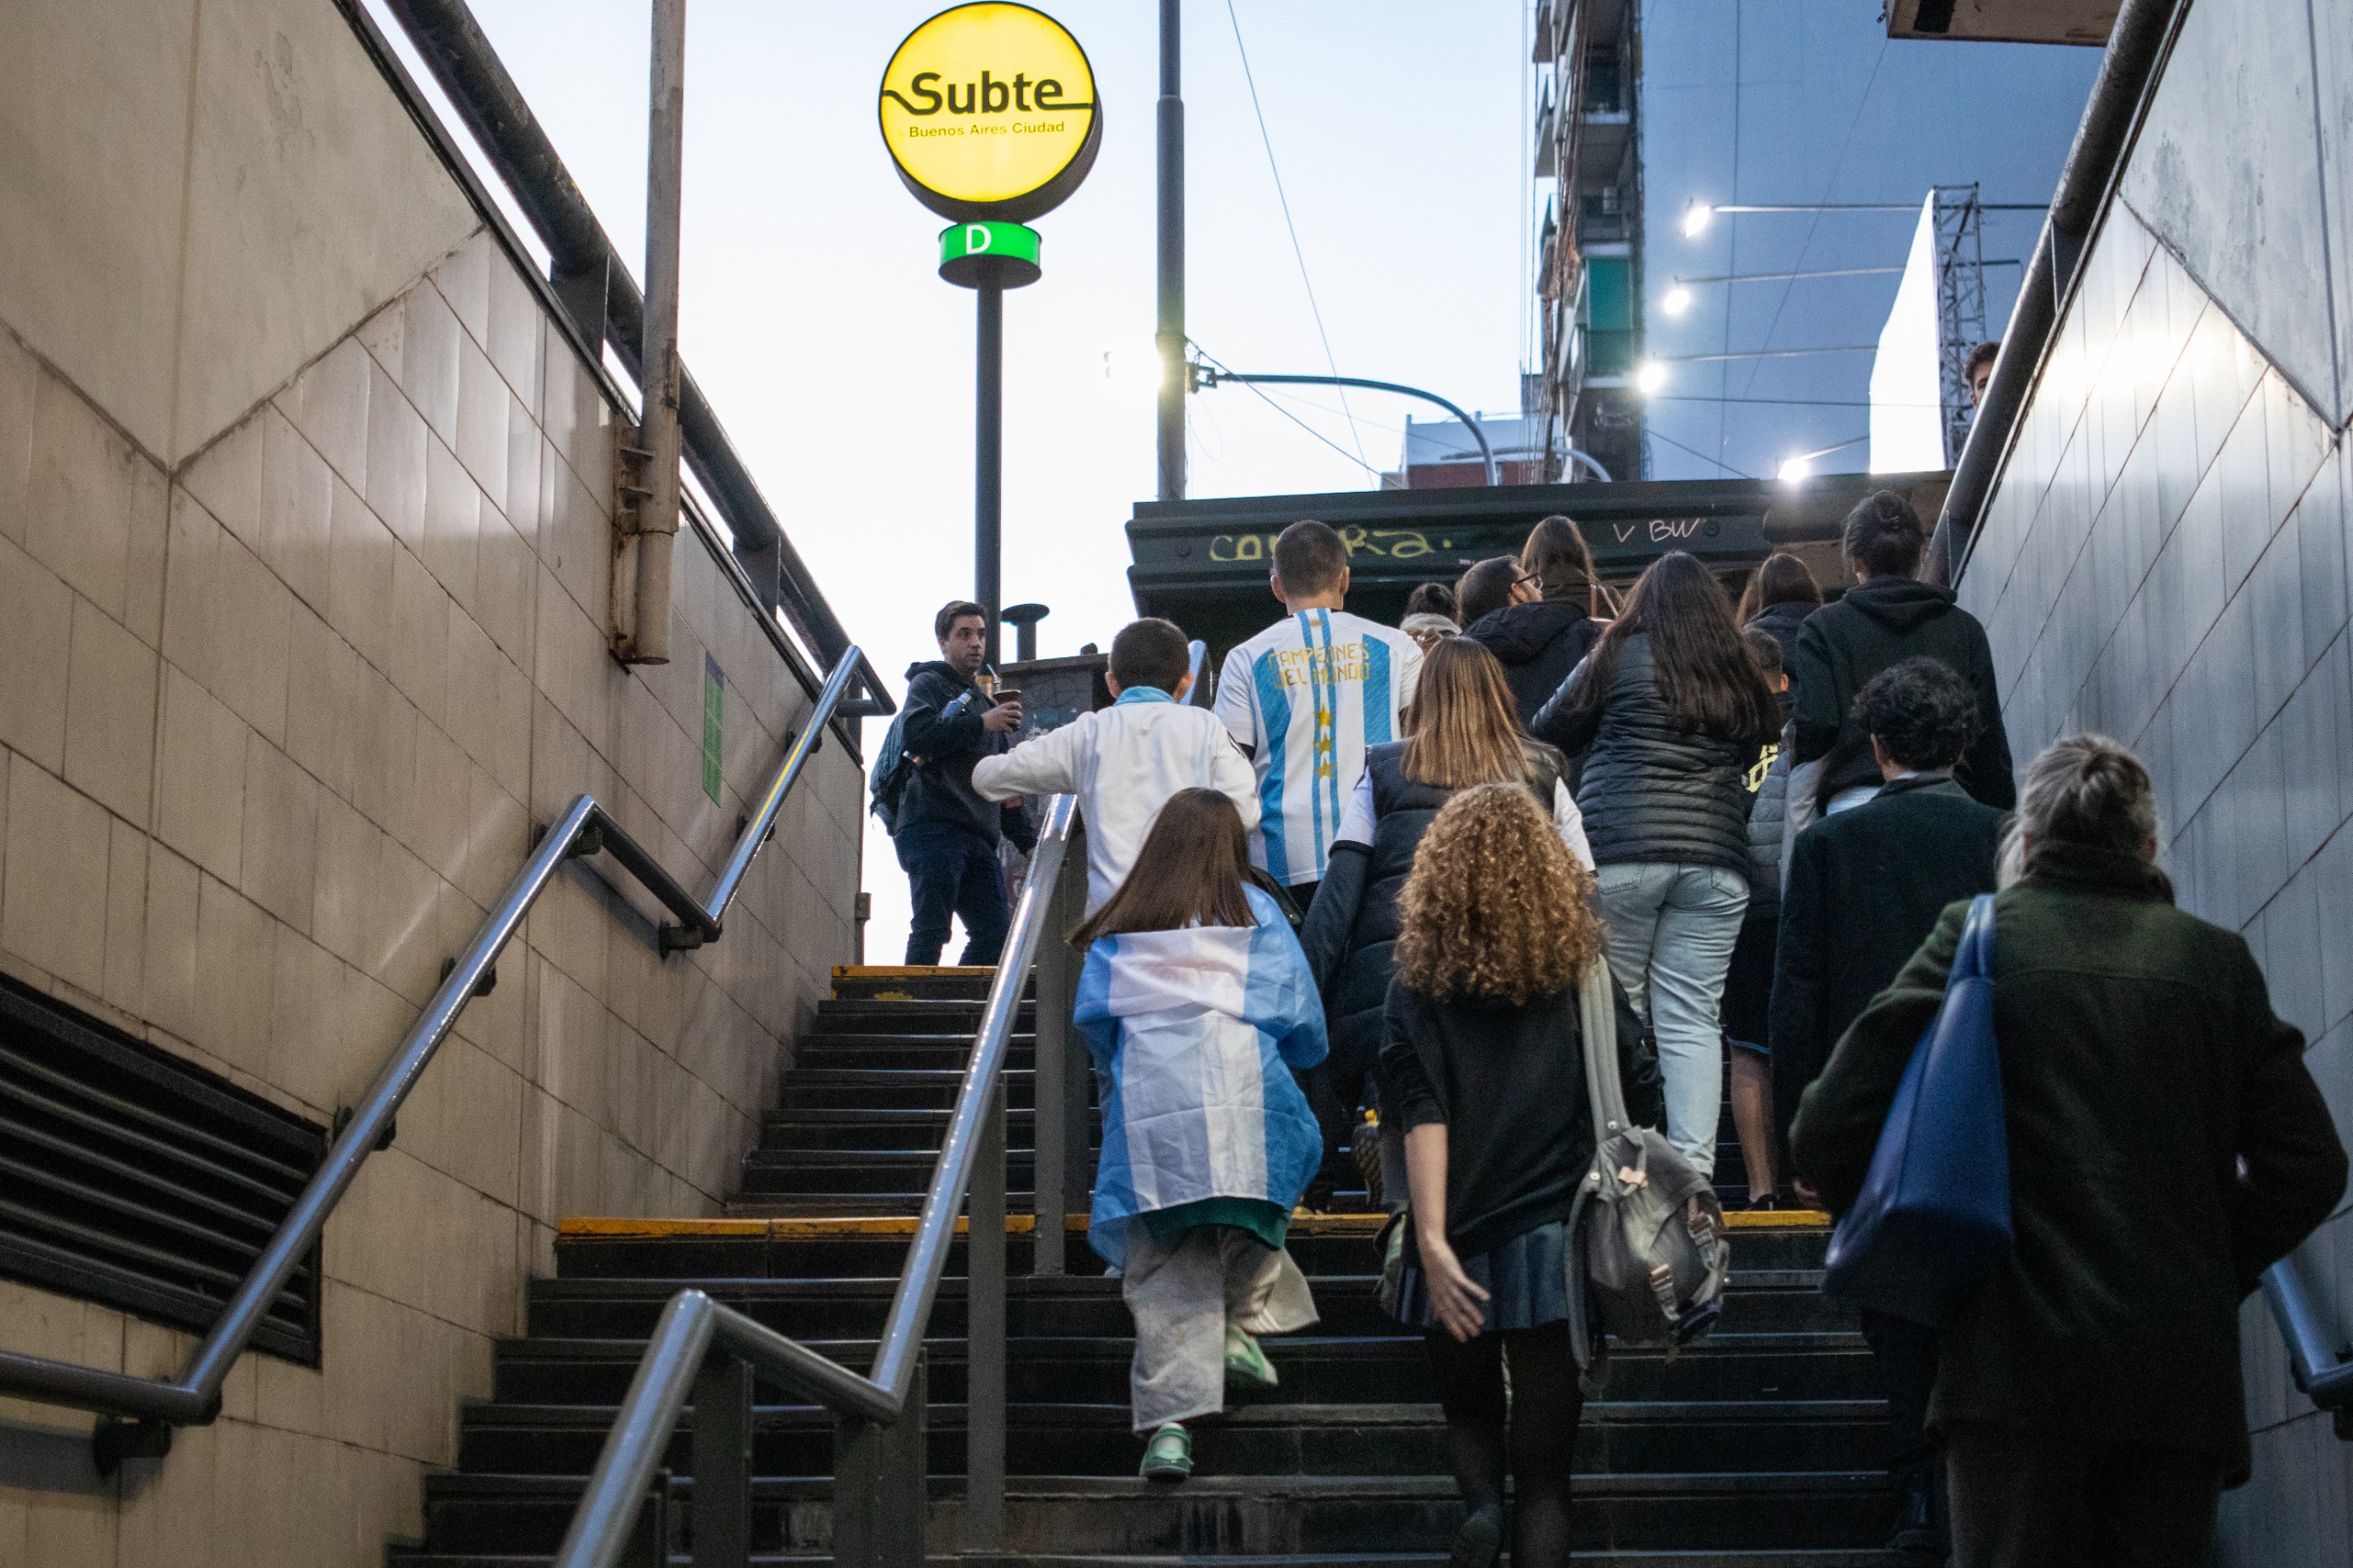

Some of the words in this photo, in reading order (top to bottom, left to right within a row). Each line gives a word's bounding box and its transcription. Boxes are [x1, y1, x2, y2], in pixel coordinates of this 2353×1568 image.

[909, 70, 1063, 116] Subte
[909, 125, 964, 138] Buenos
[970, 123, 1007, 135] Aires
[1012, 120, 1065, 134] Ciudad
[966, 224, 992, 255] D
[1268, 642, 1370, 670] CAMPEONES
[1274, 668, 1308, 689] DEL
[1313, 662, 1370, 685] MUNDO
